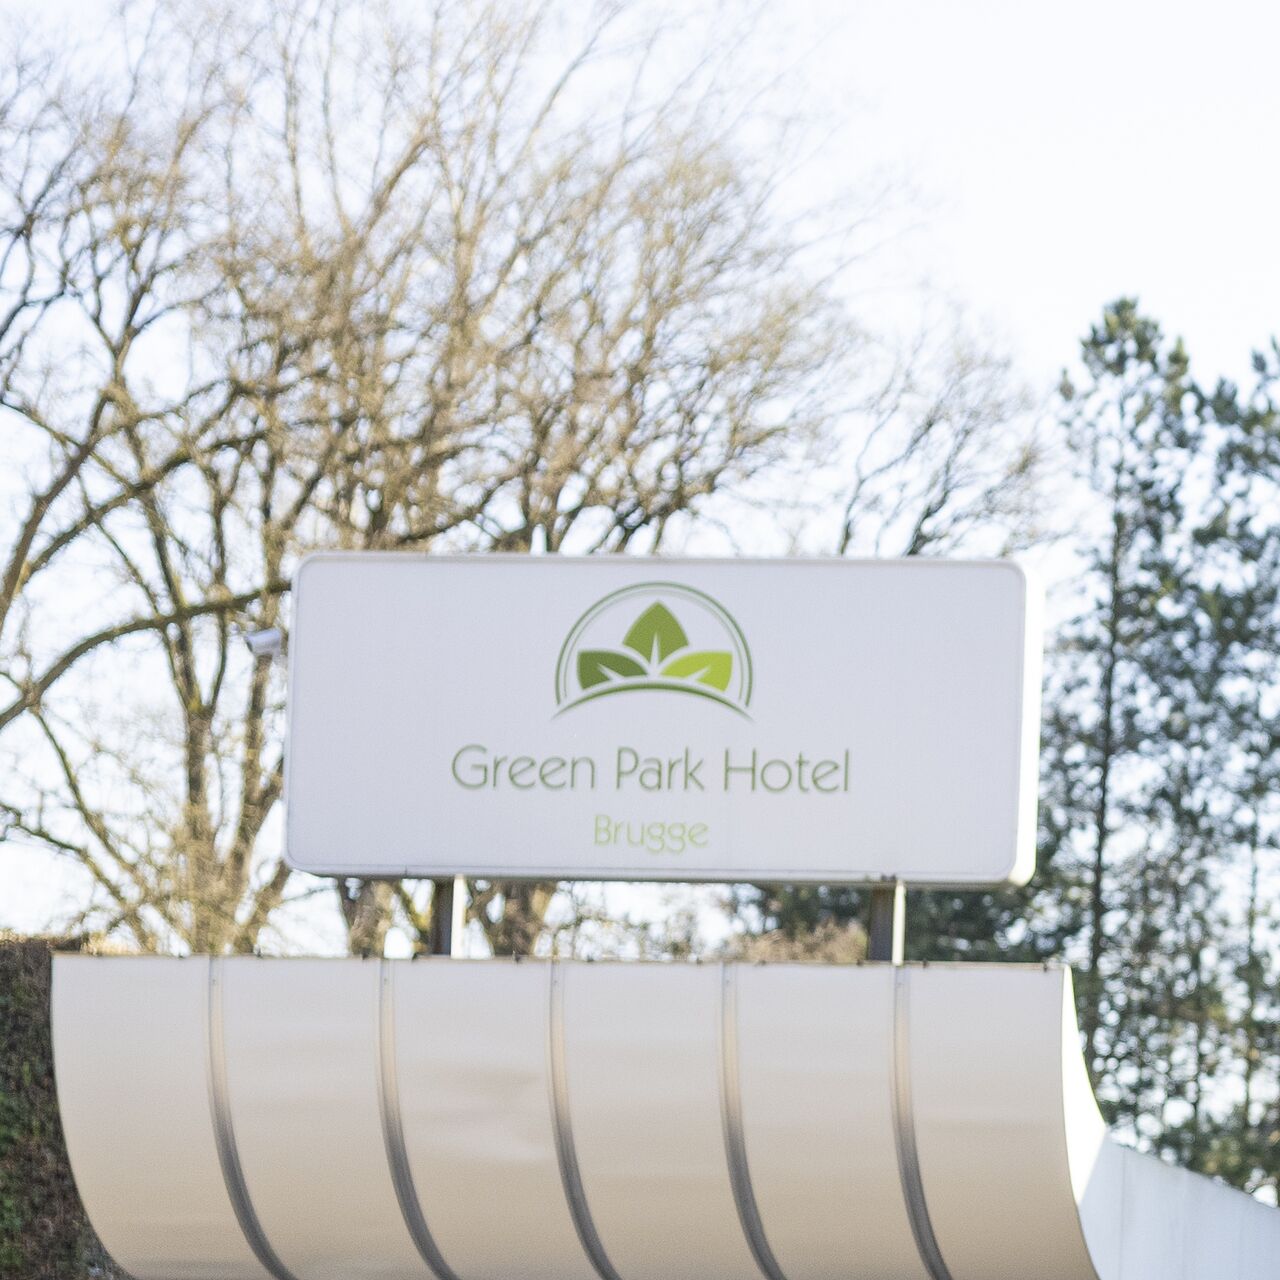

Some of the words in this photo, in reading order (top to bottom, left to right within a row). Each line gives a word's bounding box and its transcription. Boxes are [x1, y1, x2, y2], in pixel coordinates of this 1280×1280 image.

[451, 744, 596, 791] Green
[615, 746, 704, 792] Park
[723, 748, 850, 794] Hotel
[593, 813, 709, 855] Brugge
